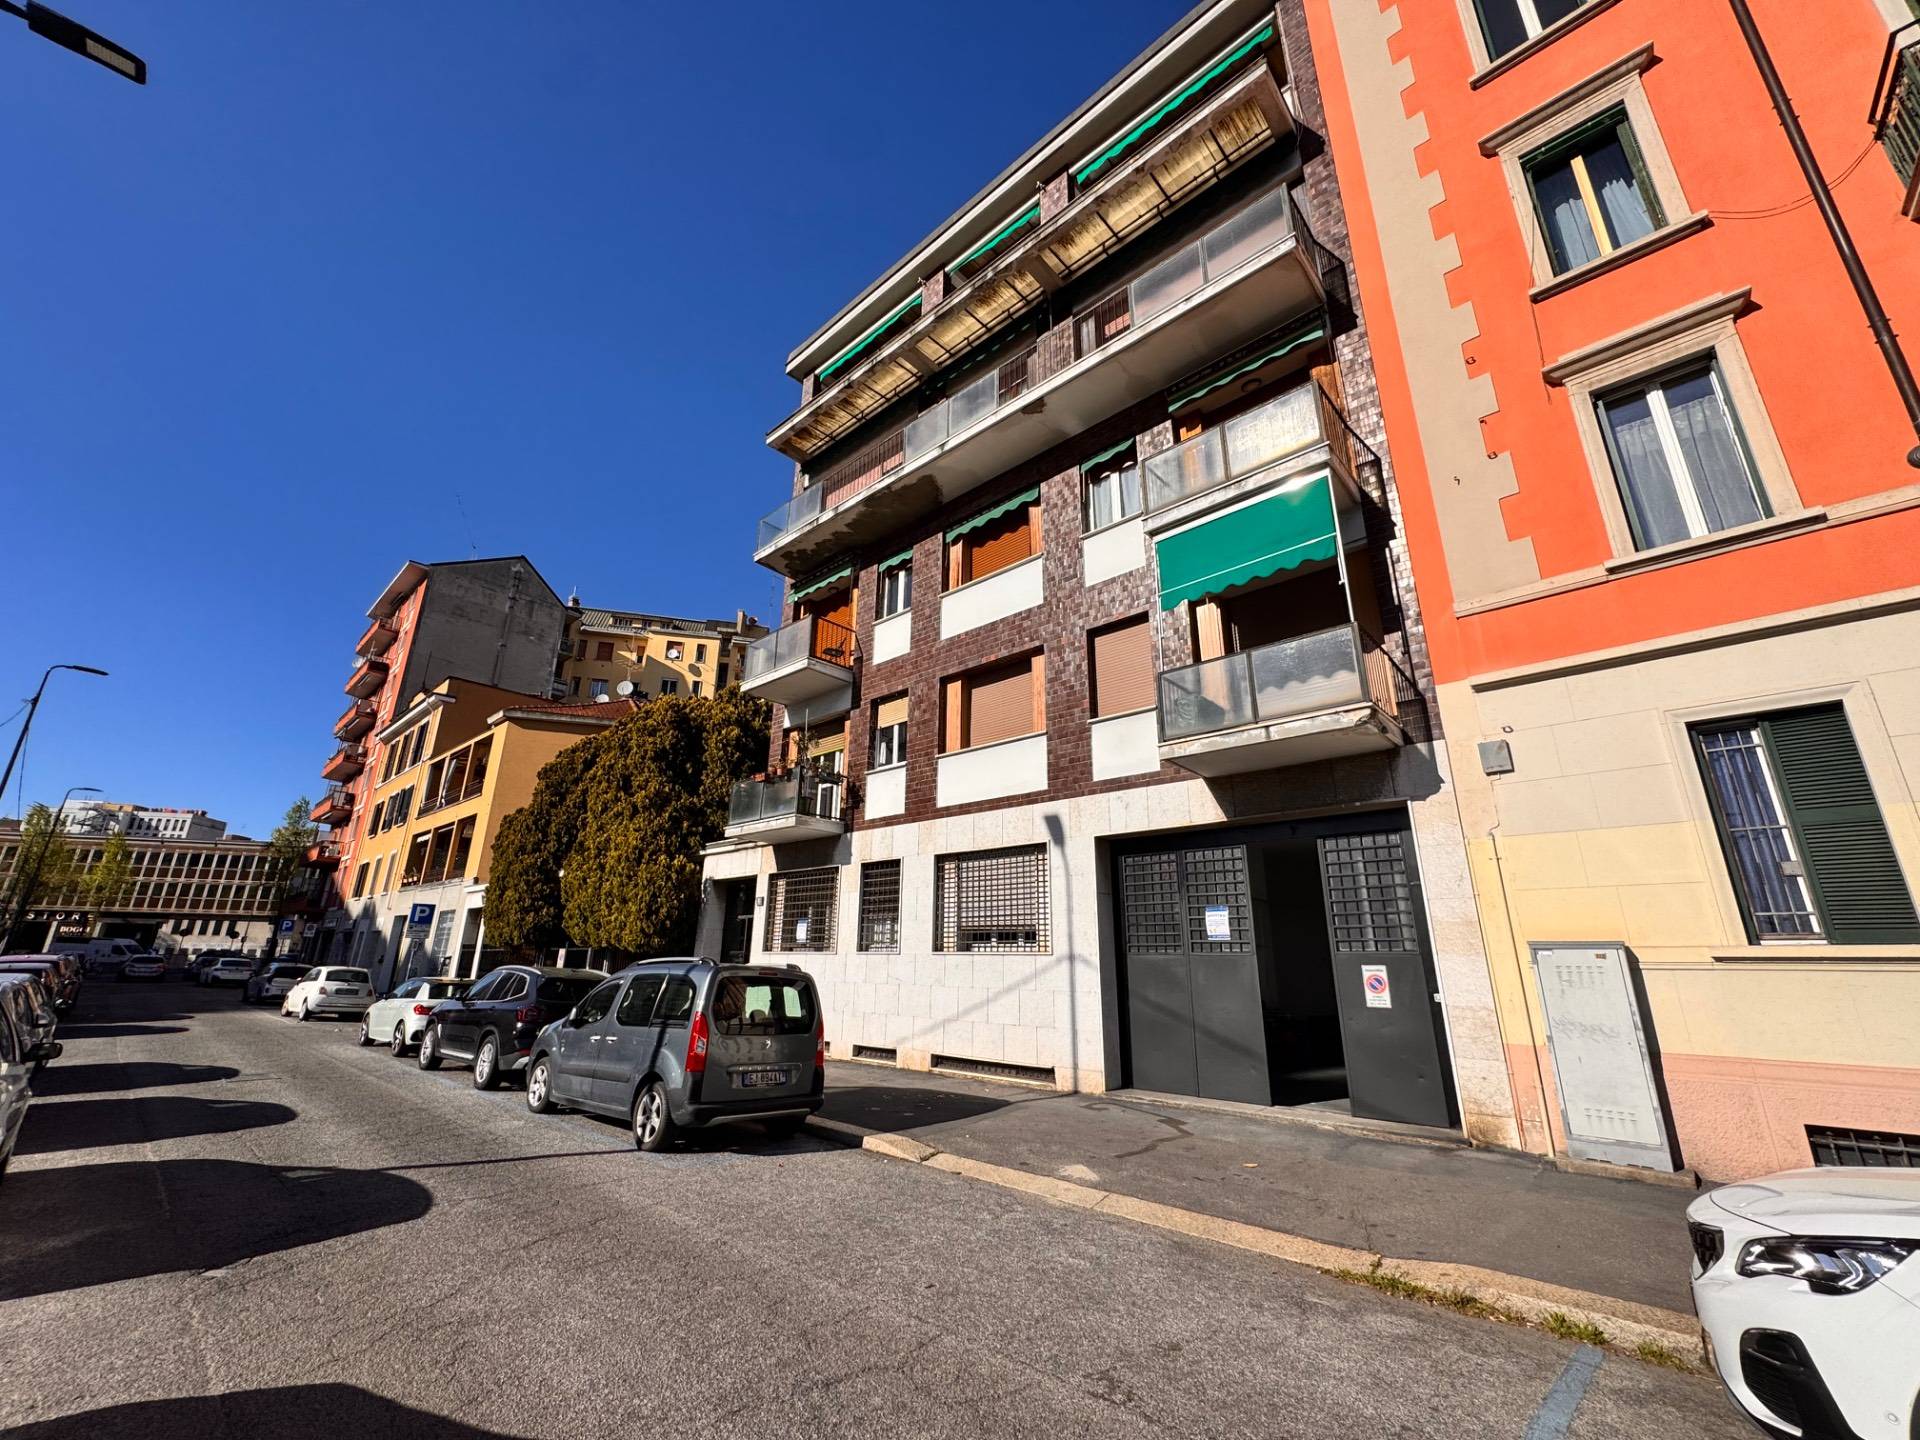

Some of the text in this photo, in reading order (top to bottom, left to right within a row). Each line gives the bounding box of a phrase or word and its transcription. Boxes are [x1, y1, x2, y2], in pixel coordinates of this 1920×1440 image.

[26, 911, 96, 921] STORE
[414, 906, 430, 921] P
[282, 920, 292, 930] P
